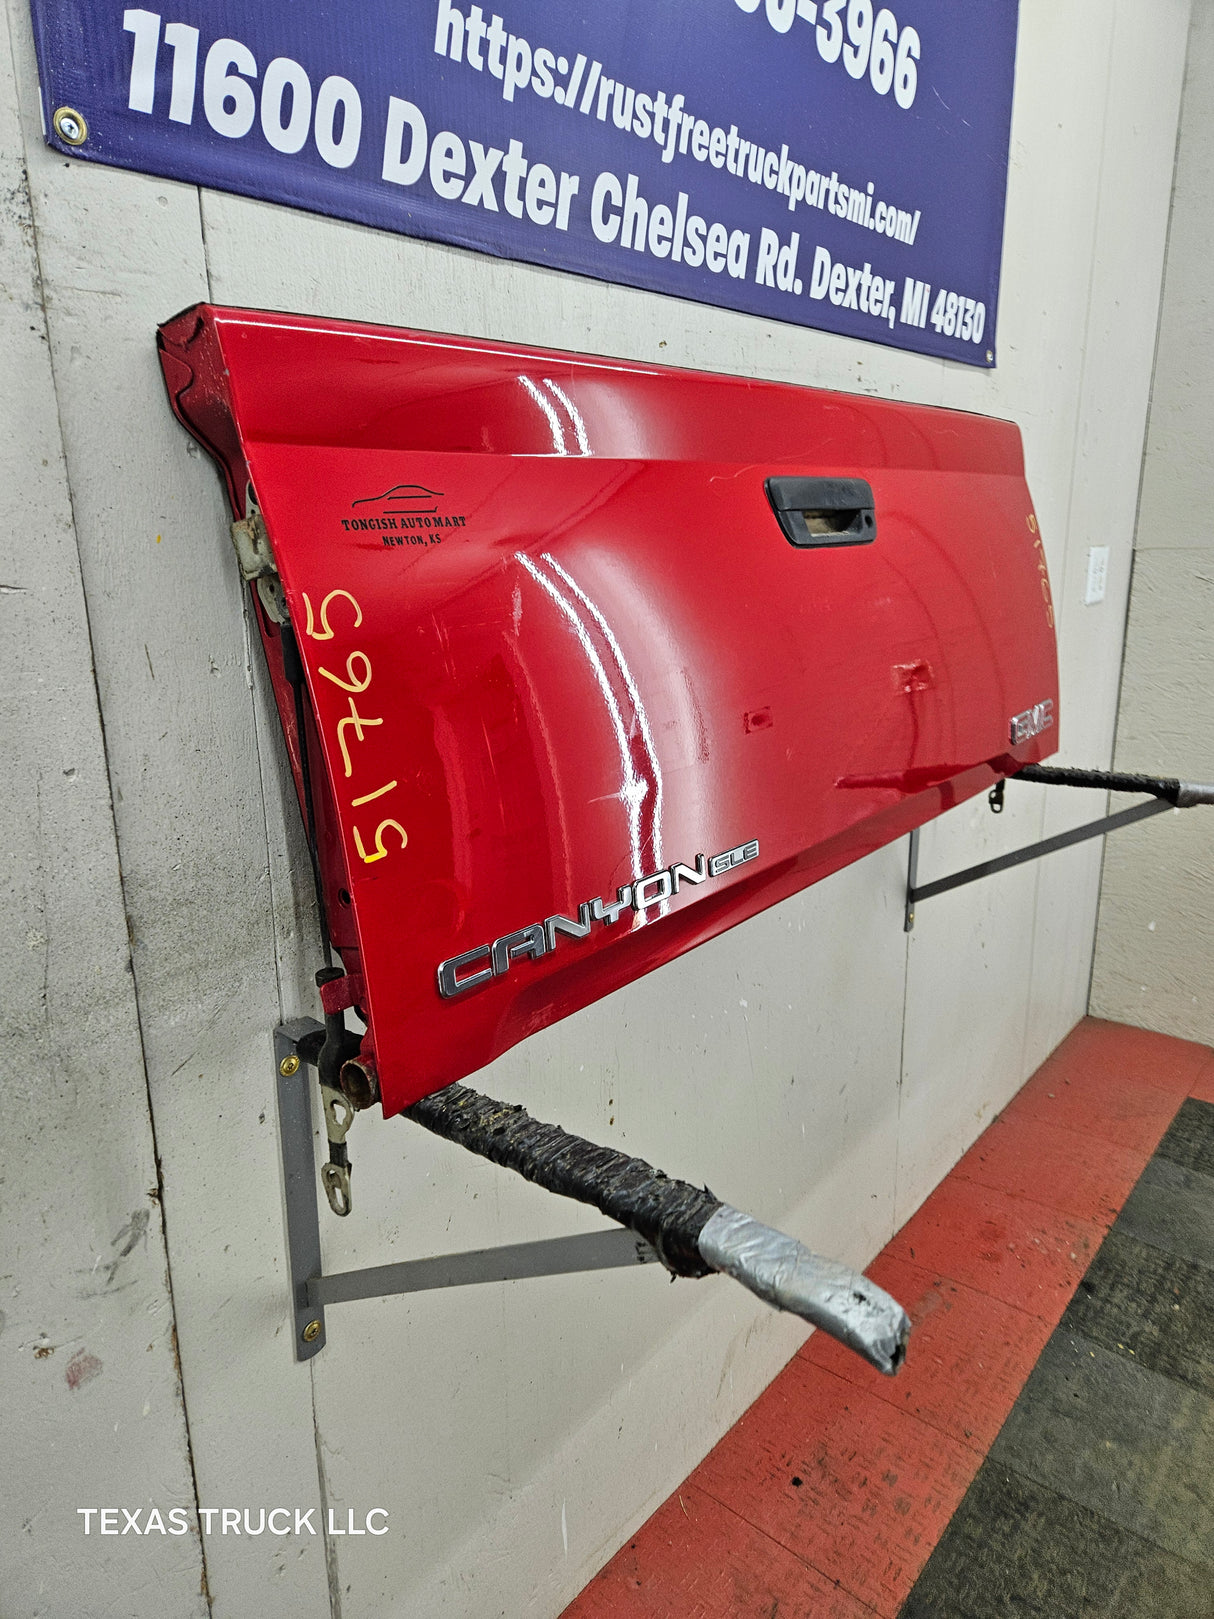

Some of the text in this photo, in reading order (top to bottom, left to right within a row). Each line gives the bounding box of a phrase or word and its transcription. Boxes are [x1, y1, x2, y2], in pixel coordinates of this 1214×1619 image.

[434, 0, 921, 246] https://rustfreetruckpartsmi.com/
[735, 0, 921, 110] -3966
[123, 9, 986, 344] 11600 Dexter Chelsea Rd. Dexter, MI 48130
[341, 518, 398, 531] TONGISH
[382, 534, 442, 547] NEWTON, KS
[303, 589, 408, 863] 51765
[437, 840, 759, 999] CANYON SLE
